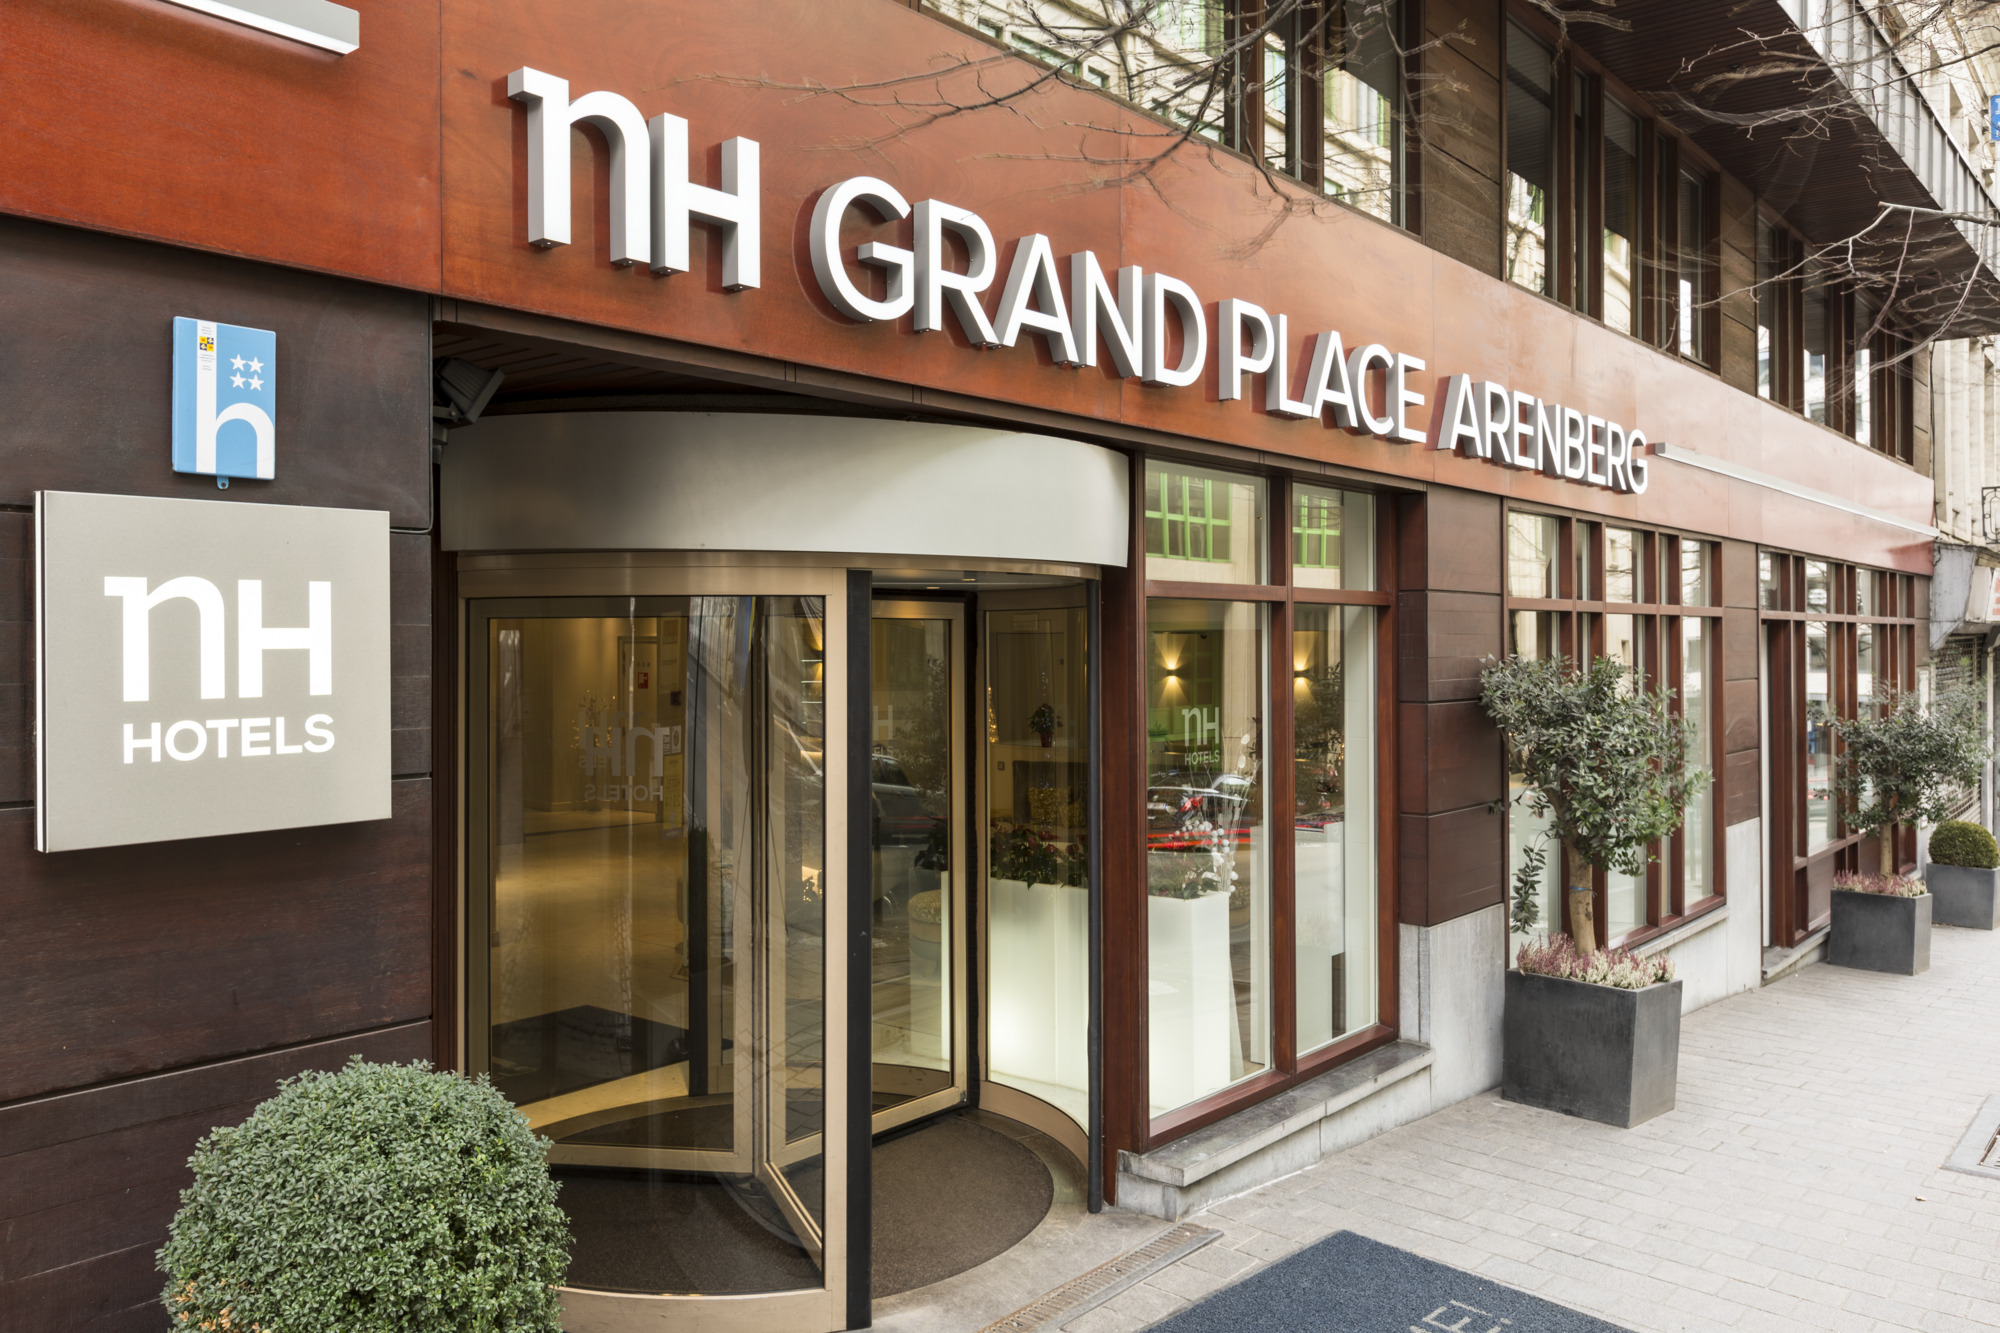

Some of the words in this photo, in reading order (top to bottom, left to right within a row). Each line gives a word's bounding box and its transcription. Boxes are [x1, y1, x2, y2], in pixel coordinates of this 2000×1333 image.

[809, 176, 1207, 387] GRAND
[1219, 298, 1427, 444] PLACE
[1437, 373, 1648, 494] ARENBERG
[123, 713, 335, 764] HOTELS
[1185, 751, 1219, 765] HOTELS
